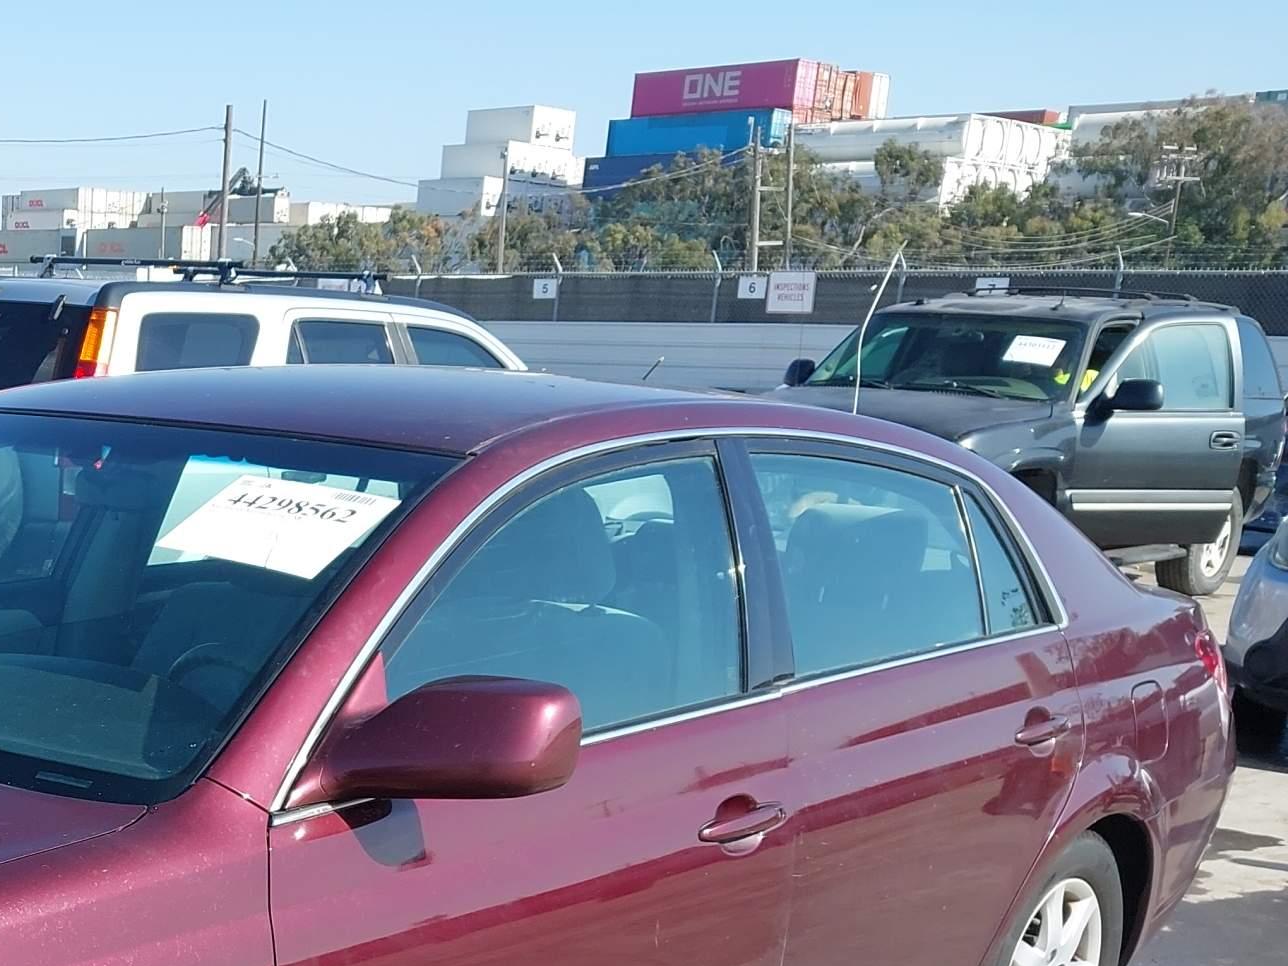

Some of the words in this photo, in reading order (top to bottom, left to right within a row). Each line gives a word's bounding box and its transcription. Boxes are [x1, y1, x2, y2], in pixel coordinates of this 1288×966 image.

[682, 70, 742, 99] ONE
[542, 283, 549, 294] 5
[748, 282, 756, 293] 6
[227, 492, 357, 524] 44298562
